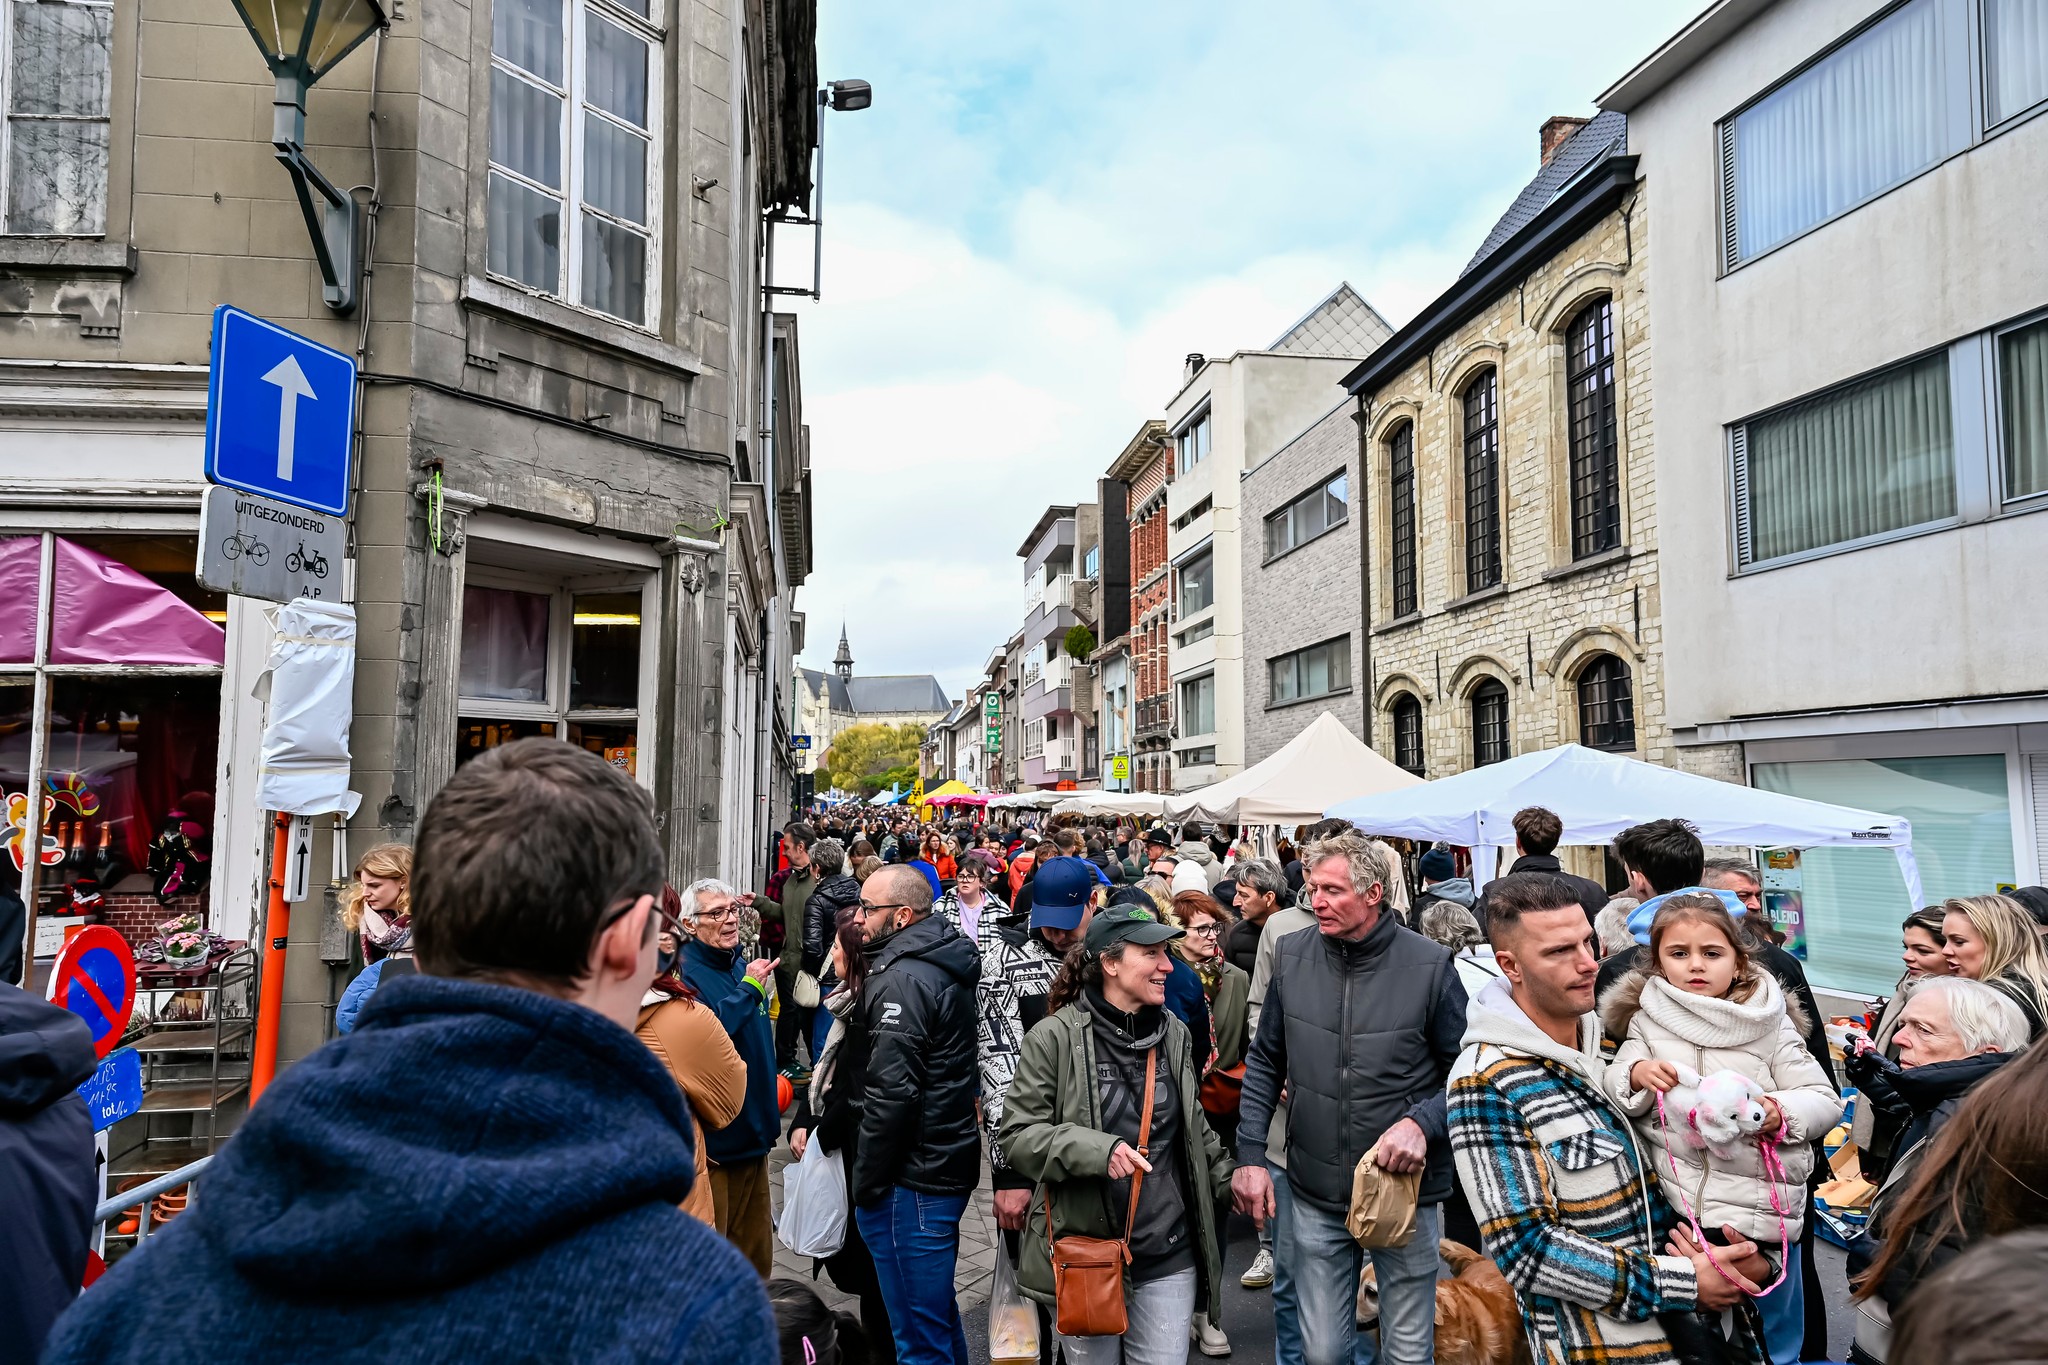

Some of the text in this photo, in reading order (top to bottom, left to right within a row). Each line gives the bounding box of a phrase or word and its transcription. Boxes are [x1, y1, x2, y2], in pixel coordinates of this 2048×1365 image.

[234, 499, 325, 534] UITGEZONDERD
[299, 815, 310, 826] 12
[299, 827, 308, 838] m
[1770, 908, 1800, 925] BLEND
[102, 1102, 115, 1118] tot
